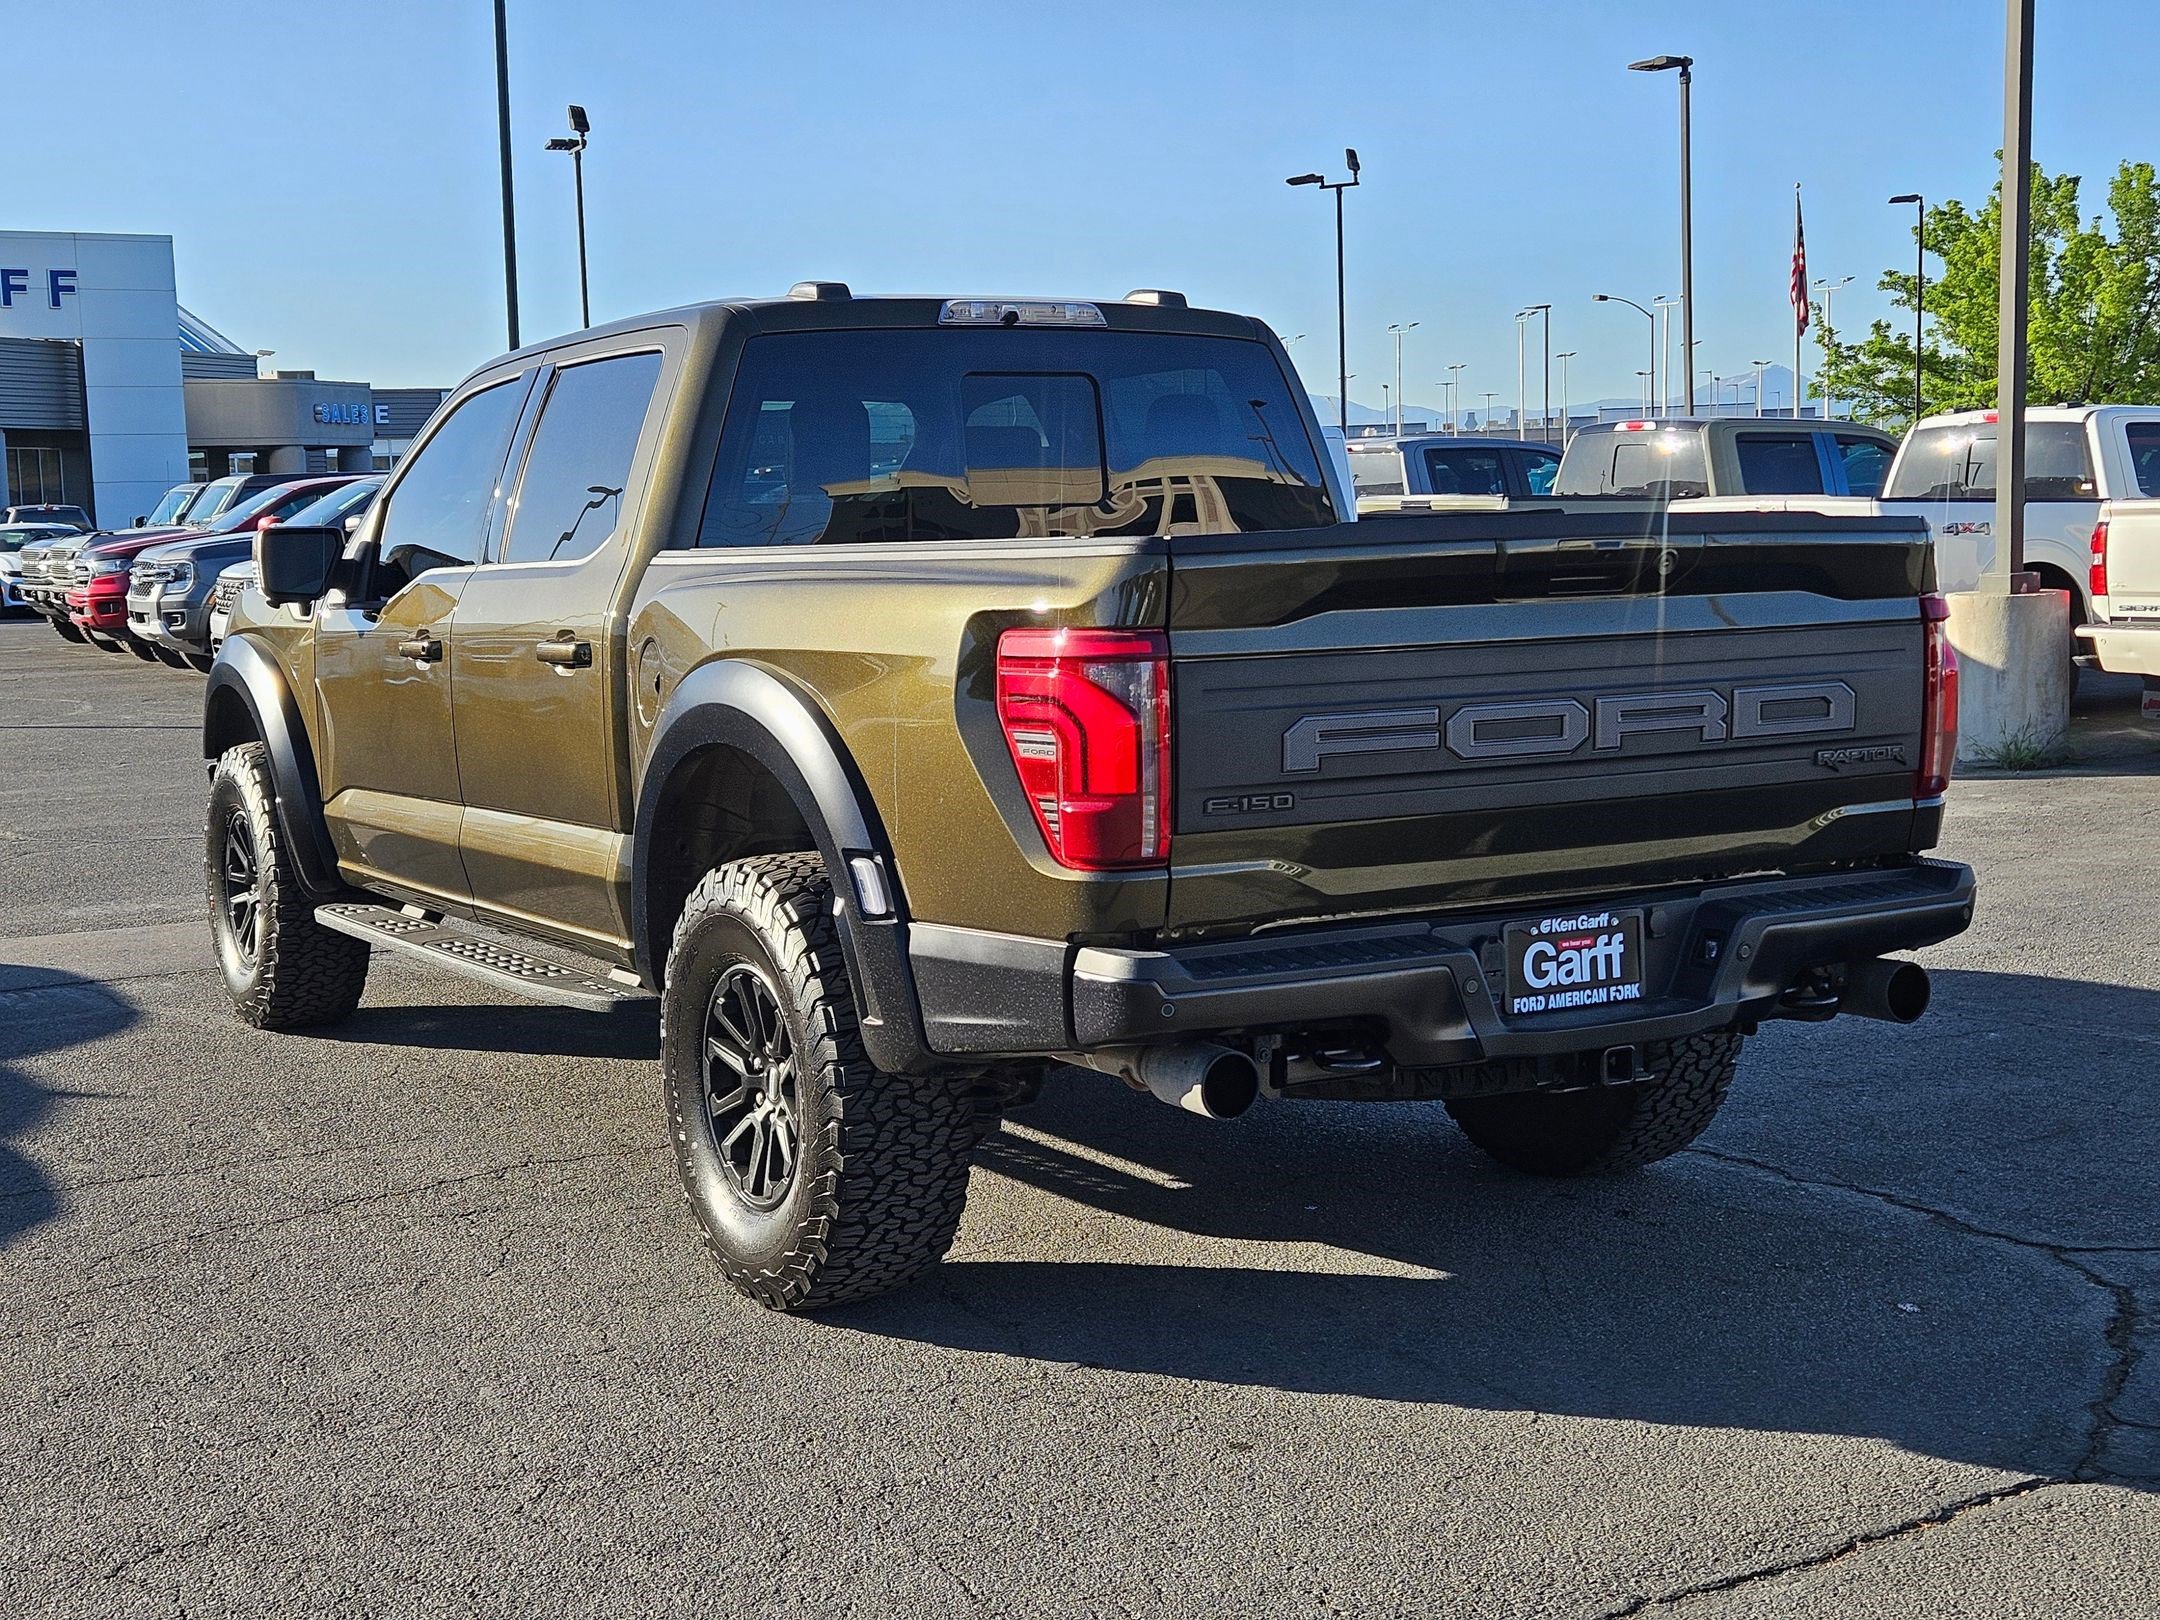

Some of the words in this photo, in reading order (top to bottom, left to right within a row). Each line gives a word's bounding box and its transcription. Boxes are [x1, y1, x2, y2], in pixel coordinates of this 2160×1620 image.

[320, 403, 369, 424] SALES
[1281, 679, 1856, 775] FORD
[1022, 748, 1055, 756] FORD
[1816, 744, 1906, 772] RAPTOR
[1205, 793, 1294, 814] F-150
[1577, 912, 1609, 930] Garff
[1523, 933, 1625, 989] Garff
[1513, 995, 1546, 1014] FORD
[1548, 988, 1607, 1009] AMERICAN
[1610, 983, 1641, 1001] FORK
